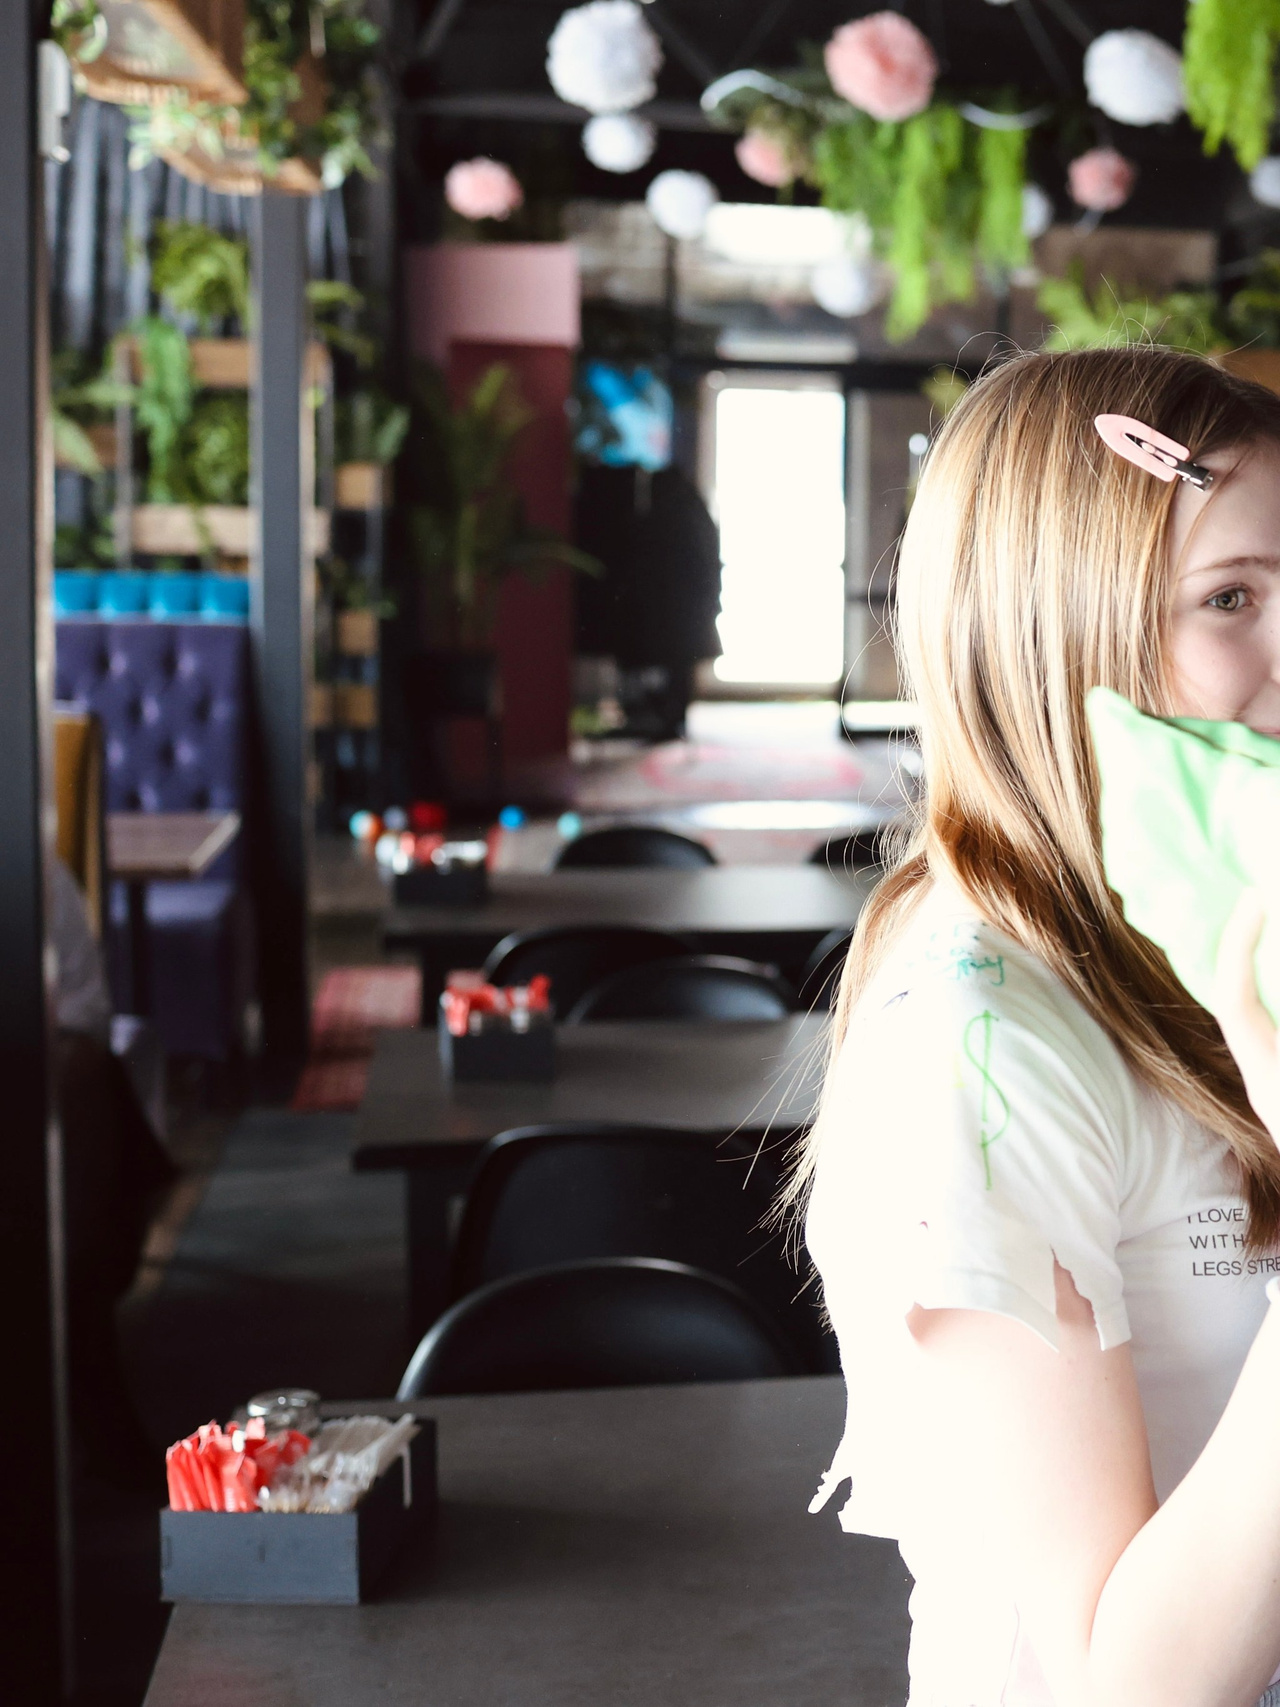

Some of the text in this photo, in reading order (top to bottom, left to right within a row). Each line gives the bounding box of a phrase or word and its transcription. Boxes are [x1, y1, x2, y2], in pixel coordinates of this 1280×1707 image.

[1198, 1208, 1245, 1223] LOVE
[1189, 1233, 1246, 1249] WITH
[1192, 1261, 1242, 1276] LEGS
